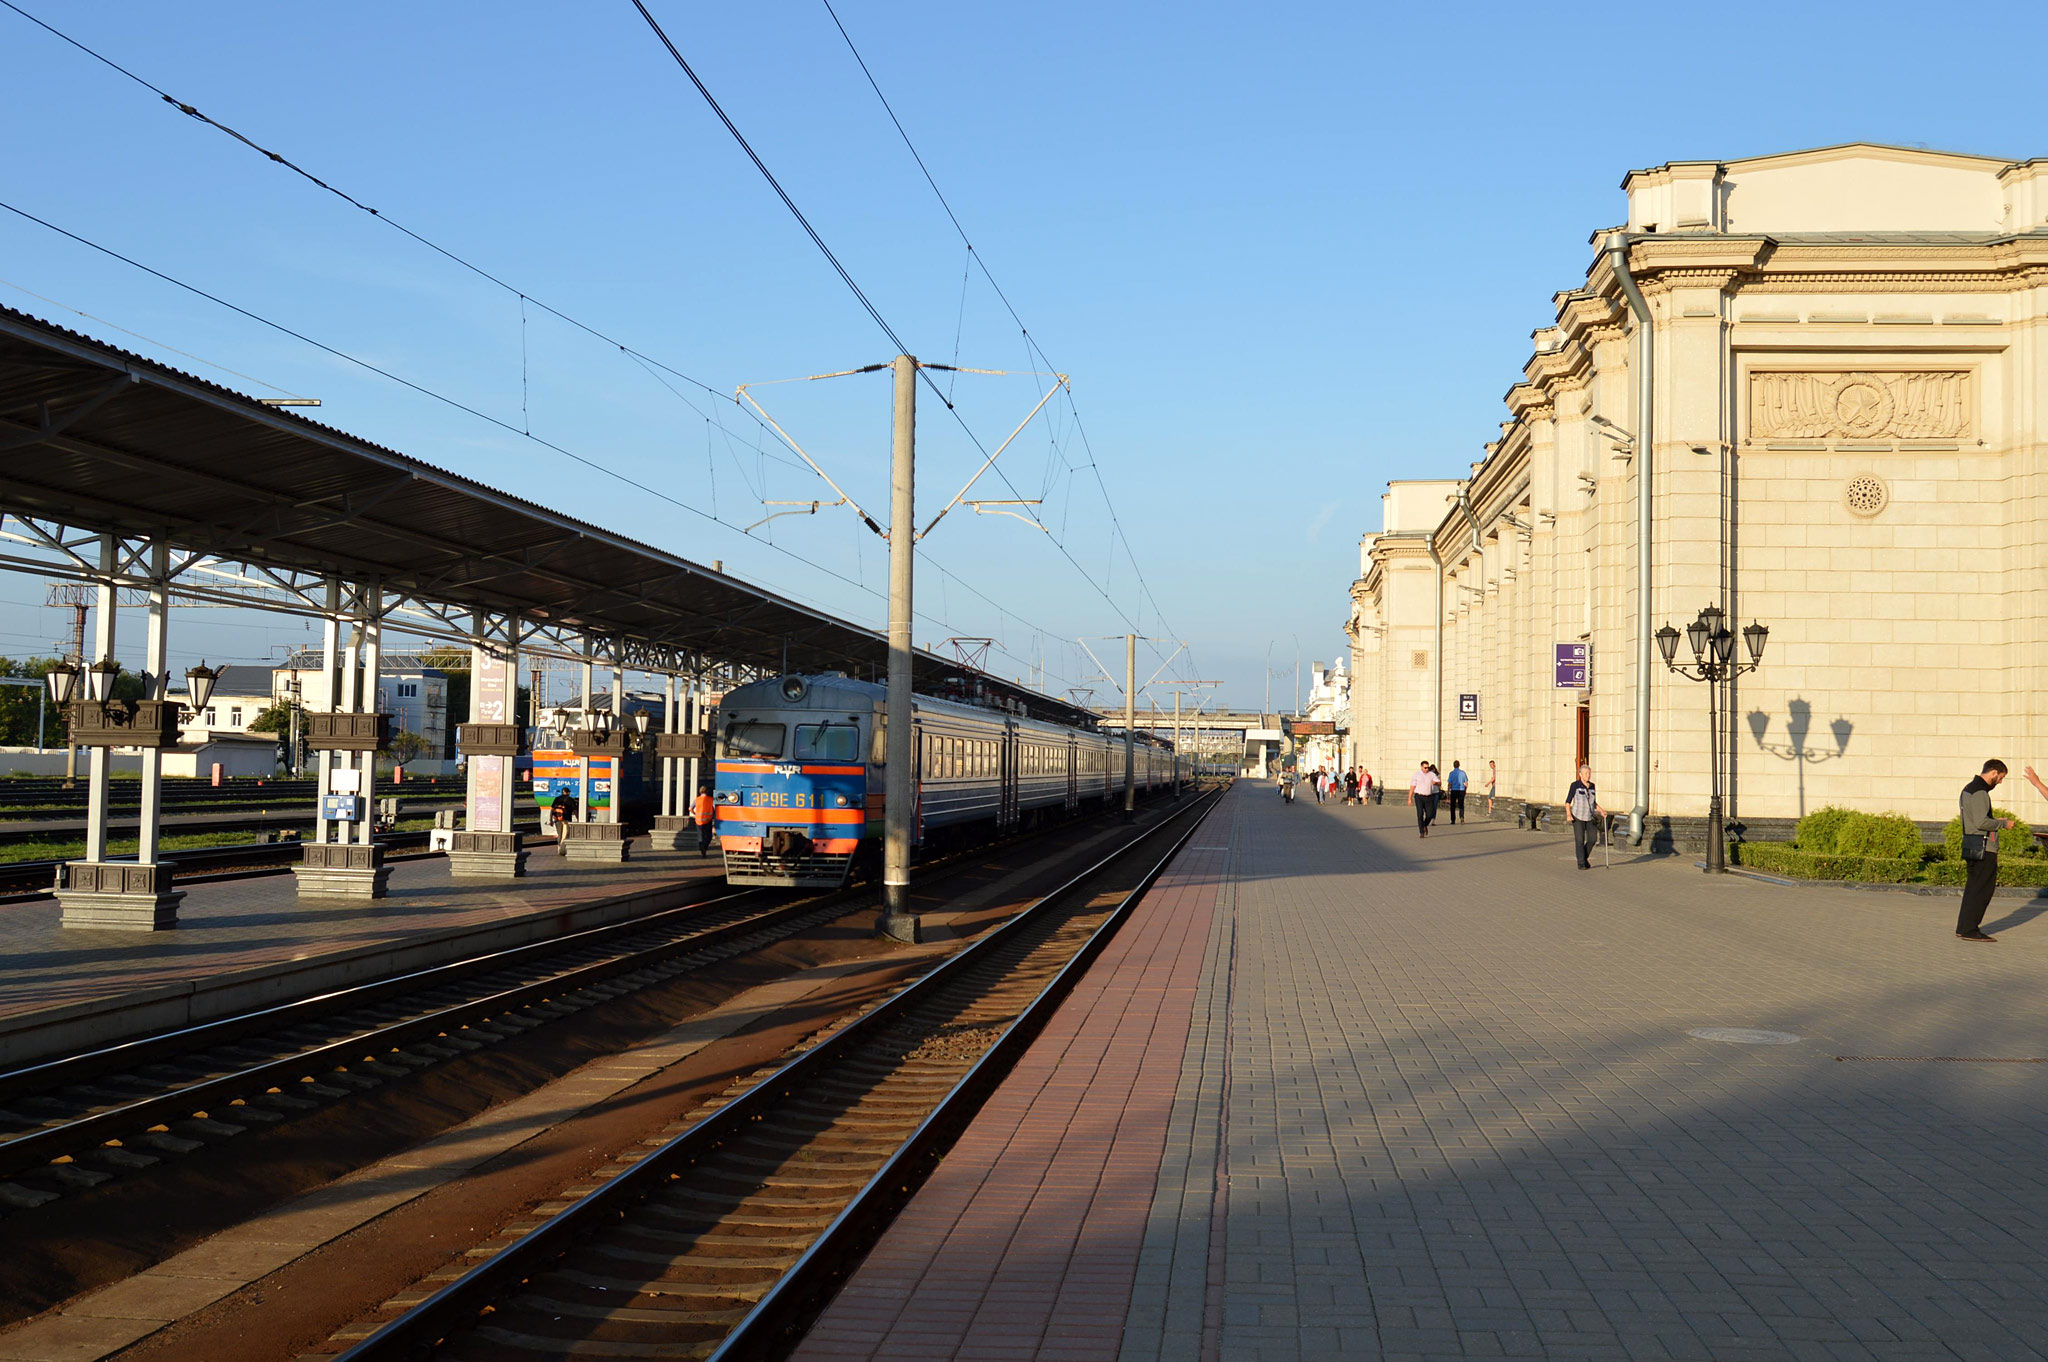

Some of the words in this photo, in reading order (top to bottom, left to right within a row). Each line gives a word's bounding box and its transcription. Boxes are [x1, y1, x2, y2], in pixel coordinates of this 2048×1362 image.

[492, 700, 503, 720] 2
[774, 765, 801, 780] RVR
[750, 792, 789, 807] ЭР9Е
[795, 793, 824, 808] 611
